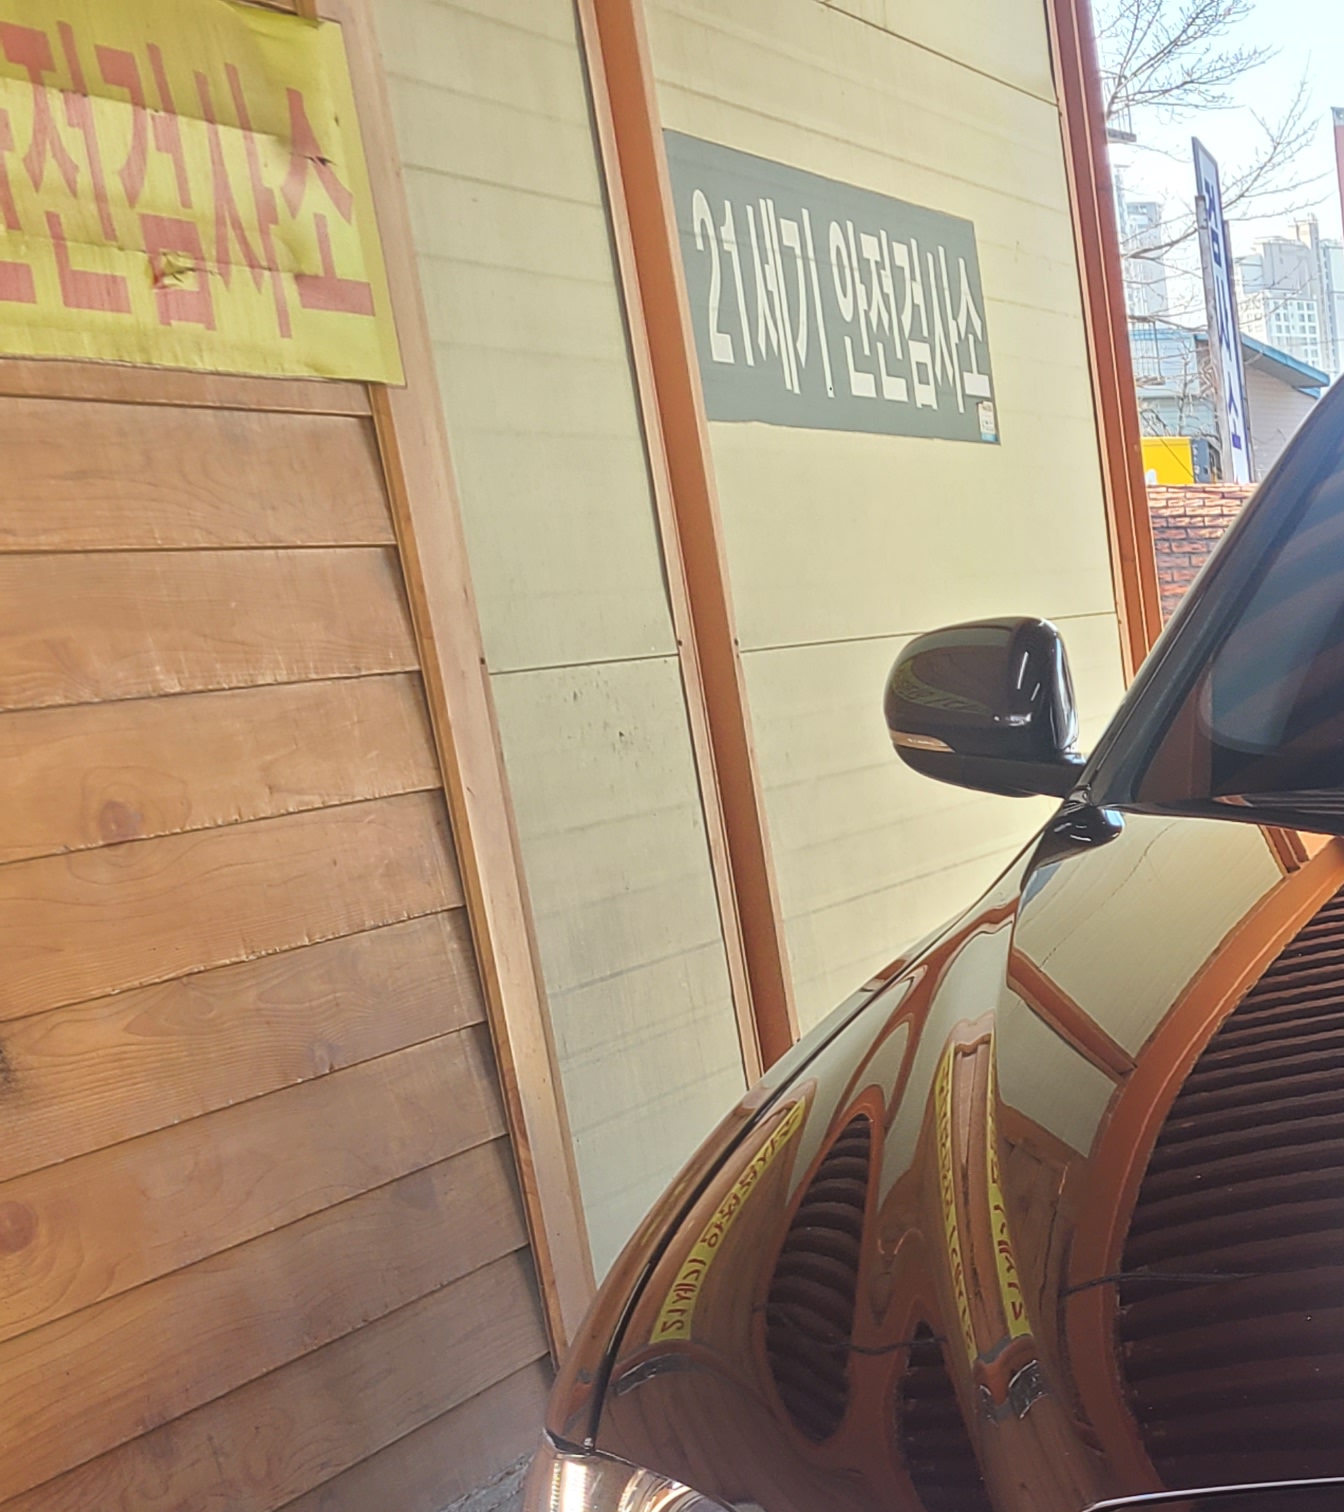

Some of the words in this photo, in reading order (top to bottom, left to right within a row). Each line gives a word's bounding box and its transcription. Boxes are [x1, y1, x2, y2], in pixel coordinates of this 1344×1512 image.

[0, 20, 376, 339] 전검사소
[692, 189, 835, 398] 21세기
[829, 220, 992, 413] 안전검사소
